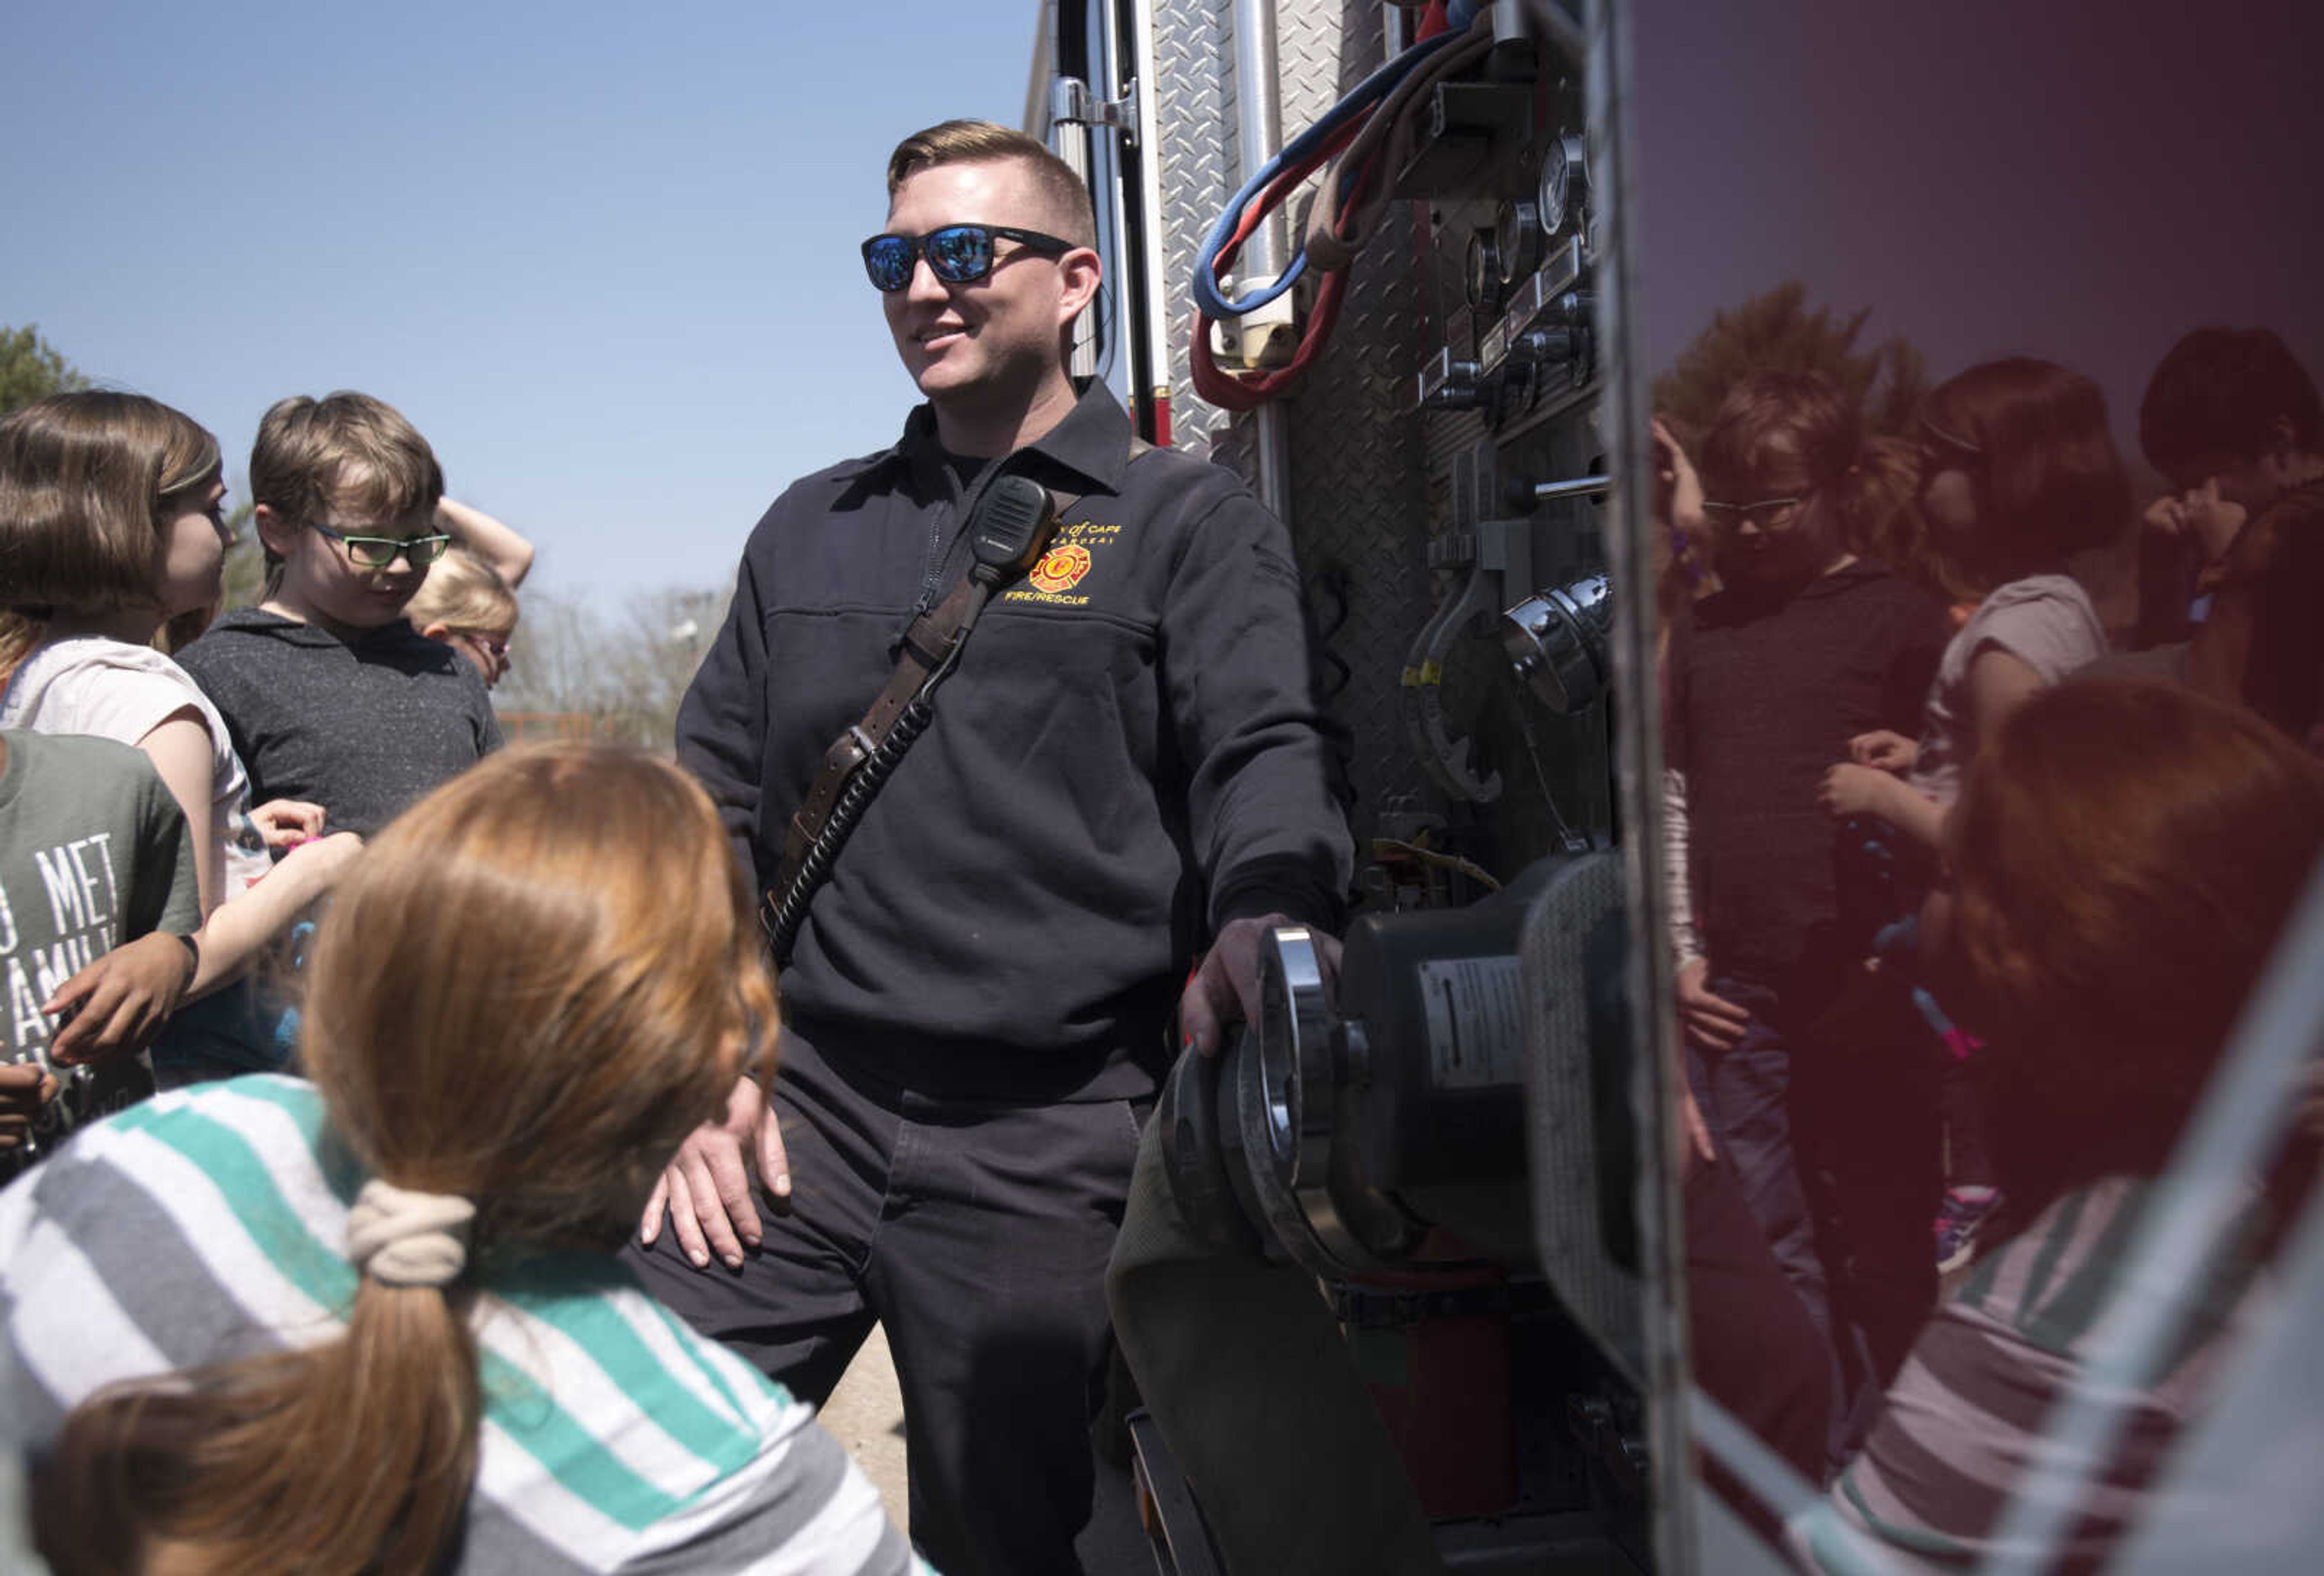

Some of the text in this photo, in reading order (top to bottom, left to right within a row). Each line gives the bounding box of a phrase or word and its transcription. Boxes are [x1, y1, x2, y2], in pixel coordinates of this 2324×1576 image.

[1069, 520, 1090, 537] of
[1005, 591, 1090, 605] FIRE/RESCUE
[34, 832, 117, 934] MET
